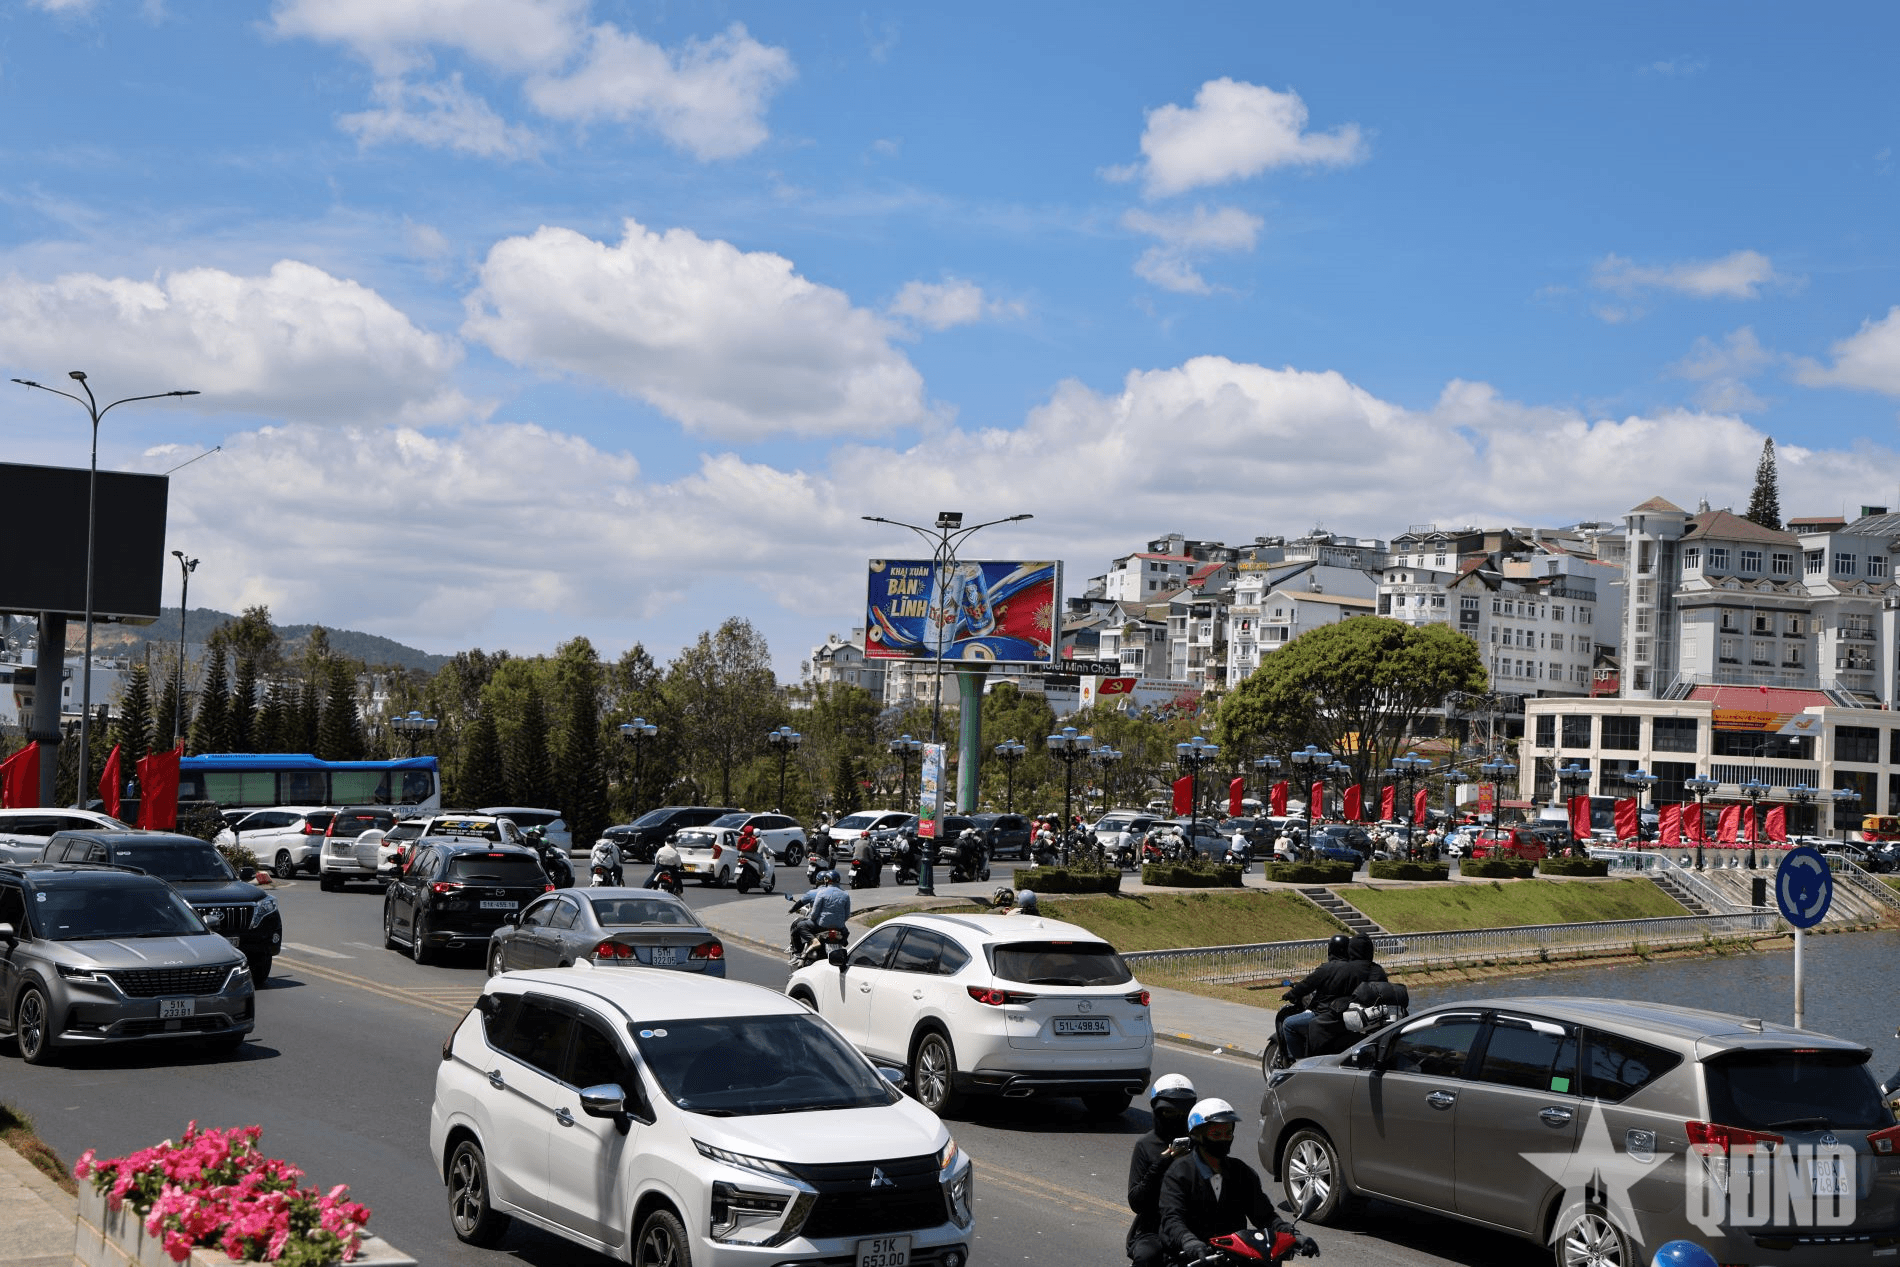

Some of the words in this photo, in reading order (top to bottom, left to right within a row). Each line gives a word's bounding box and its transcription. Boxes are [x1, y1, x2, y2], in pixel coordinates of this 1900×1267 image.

[890, 567, 908, 577] KHAI
[909, 566, 929, 577] XUÂN
[888, 574, 918, 596] BẢN
[890, 596, 928, 617] LĨNH
[1065, 662, 1089, 672] Minh
[1091, 663, 1116, 674] Châu
[170, 1000, 185, 1008] 51K
[873, 1238, 896, 1253] 51K
[863, 1252, 904, 1267] 653.00
